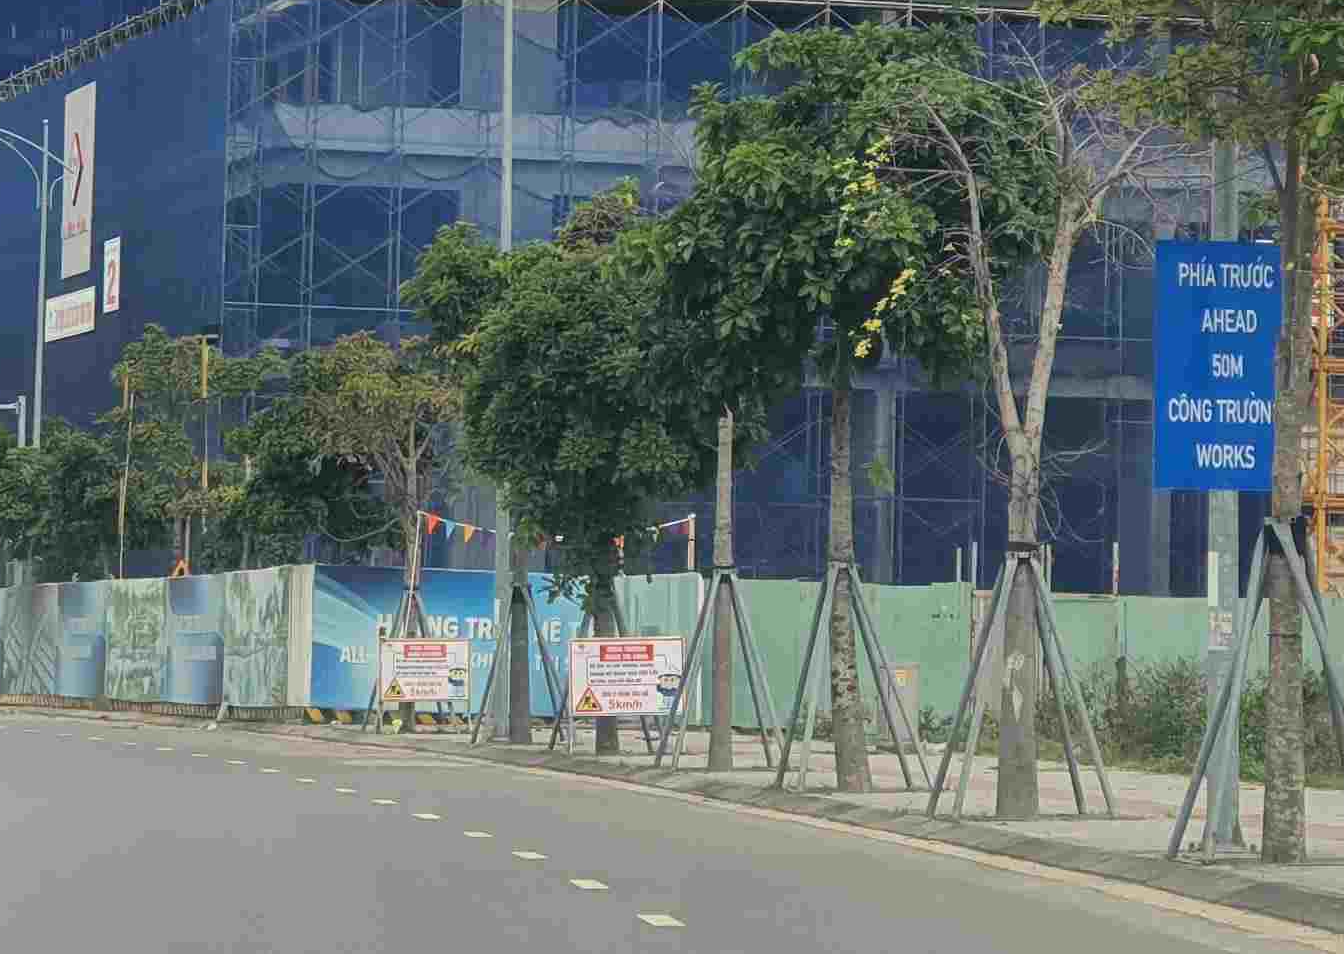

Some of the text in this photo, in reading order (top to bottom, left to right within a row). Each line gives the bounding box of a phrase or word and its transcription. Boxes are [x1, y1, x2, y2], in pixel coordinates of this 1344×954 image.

[1177, 256, 1274, 288] PHÍA TRƯỚC
[1201, 309, 1257, 333] AHEAD
[1212, 353, 1244, 378] 50M
[1168, 391, 1274, 424] CÔNG TRƯỜN
[1196, 443, 1257, 469] WORKS
